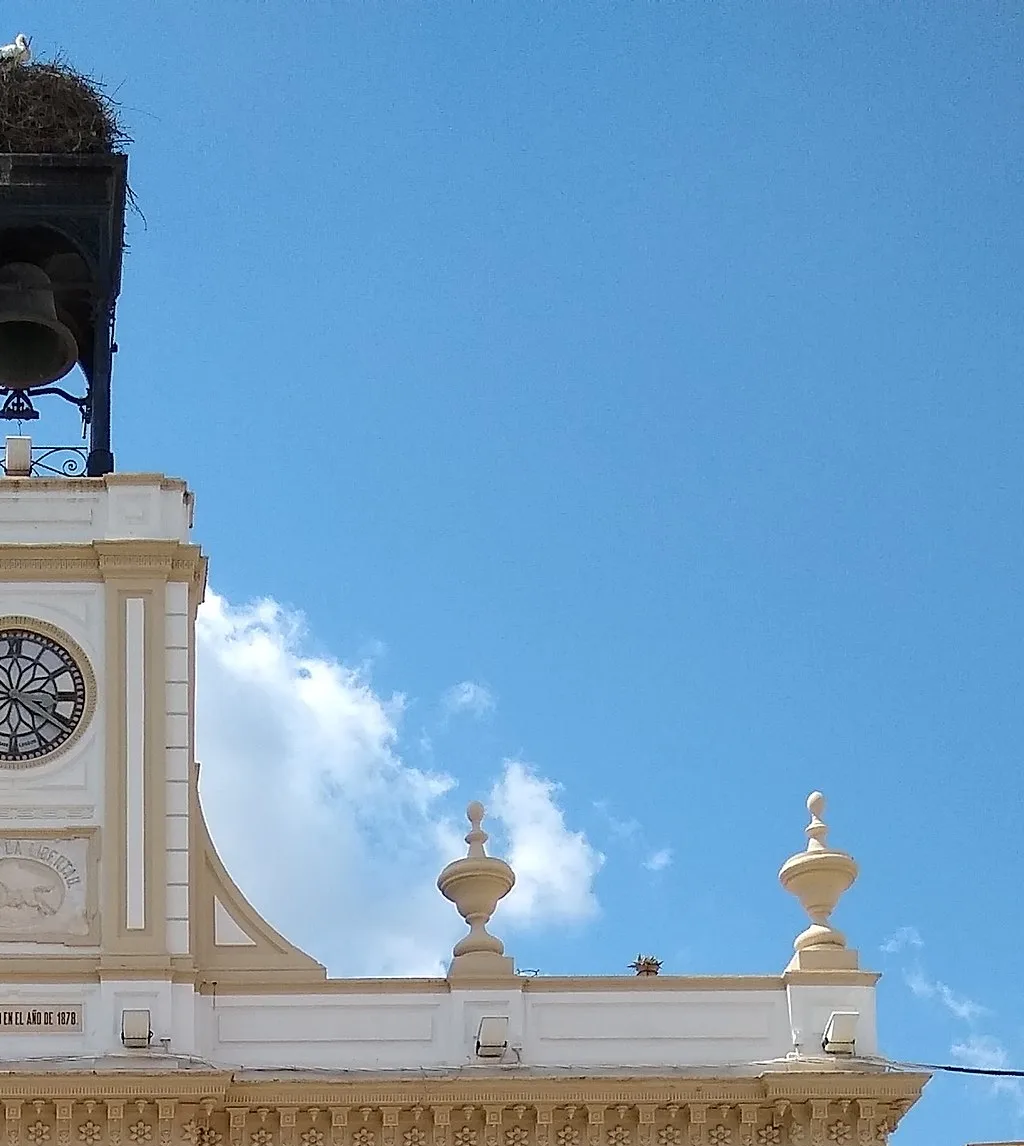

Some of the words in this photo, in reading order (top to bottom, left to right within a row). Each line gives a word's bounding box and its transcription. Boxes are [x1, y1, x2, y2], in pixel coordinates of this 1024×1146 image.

[5, 840, 22, 856] LA
[3, 1011, 13, 1026] EN
[15, 1011, 24, 1026] EL
[26, 1009, 42, 1026] AÑO
[44, 1011, 54, 1026] DE
